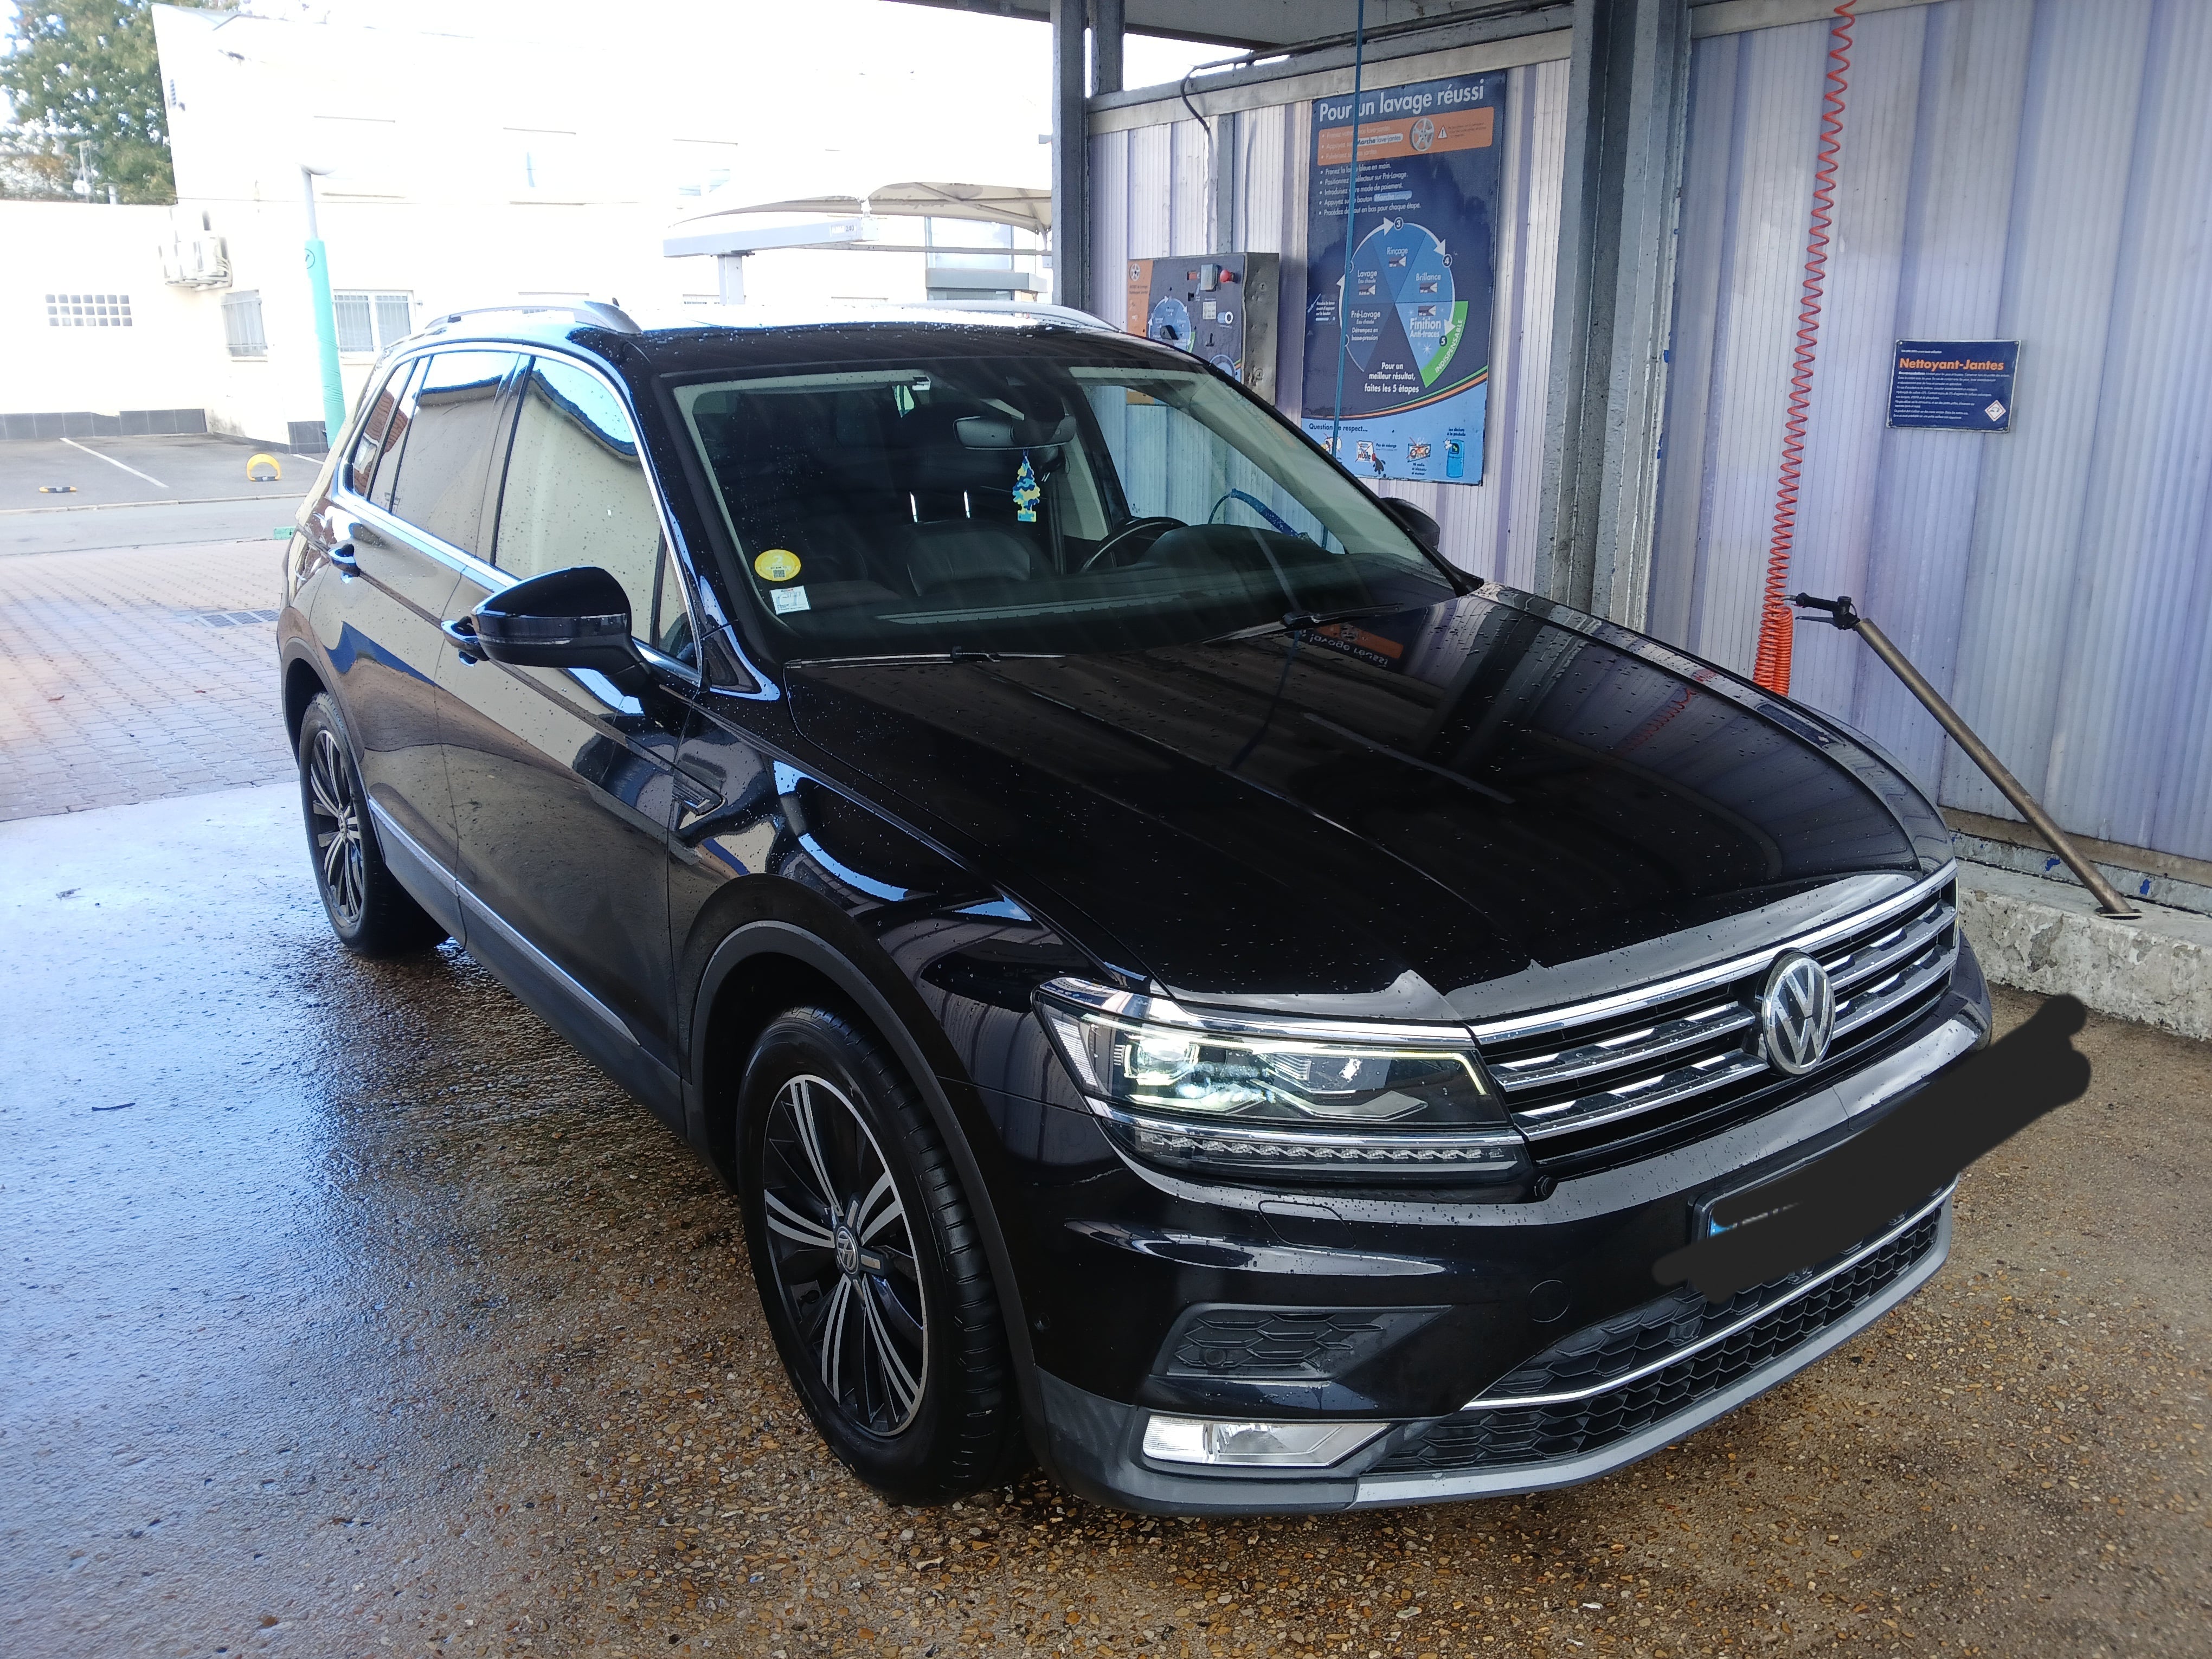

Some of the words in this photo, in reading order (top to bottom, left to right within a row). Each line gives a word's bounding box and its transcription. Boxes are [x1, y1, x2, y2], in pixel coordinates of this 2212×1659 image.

[1320, 103, 1353, 122] Pour
[1359, 102, 1374, 117] un
[1380, 92, 1432, 114] lavage
[1437, 79, 1484, 106] réussi
[1359, 164, 1371, 172] bleue
[1361, 184, 1373, 192] mode
[1374, 183, 1380, 191] de
[1324, 199, 1343, 207] Appuyez
[1357, 195, 1373, 203] bouton
[1324, 207, 1343, 216] Procédez
[1368, 204, 1377, 213] bas
[1377, 205, 1388, 214] pour
[1388, 202, 1406, 212] chaque
[1386, 247, 1409, 256] Rinçage
[1358, 270, 1377, 279] Lavage
[1416, 273, 1441, 281] Brillance
[1351, 310, 1381, 319] Pré-Lavage
[1410, 318, 1441, 331] Finition
[1410, 330, 1441, 338] Anti-traces
[1435, 319, 1463, 374] INDISPENSABLE
[1899, 358, 2004, 372] Nettoyant-Jantes
[1369, 371, 1391, 380] meilleur
[1392, 371, 1416, 381] résultat,
[1364, 384, 1381, 393] faites
[1382, 384, 1391, 393] les
[1398, 384, 1419, 395] étapes
